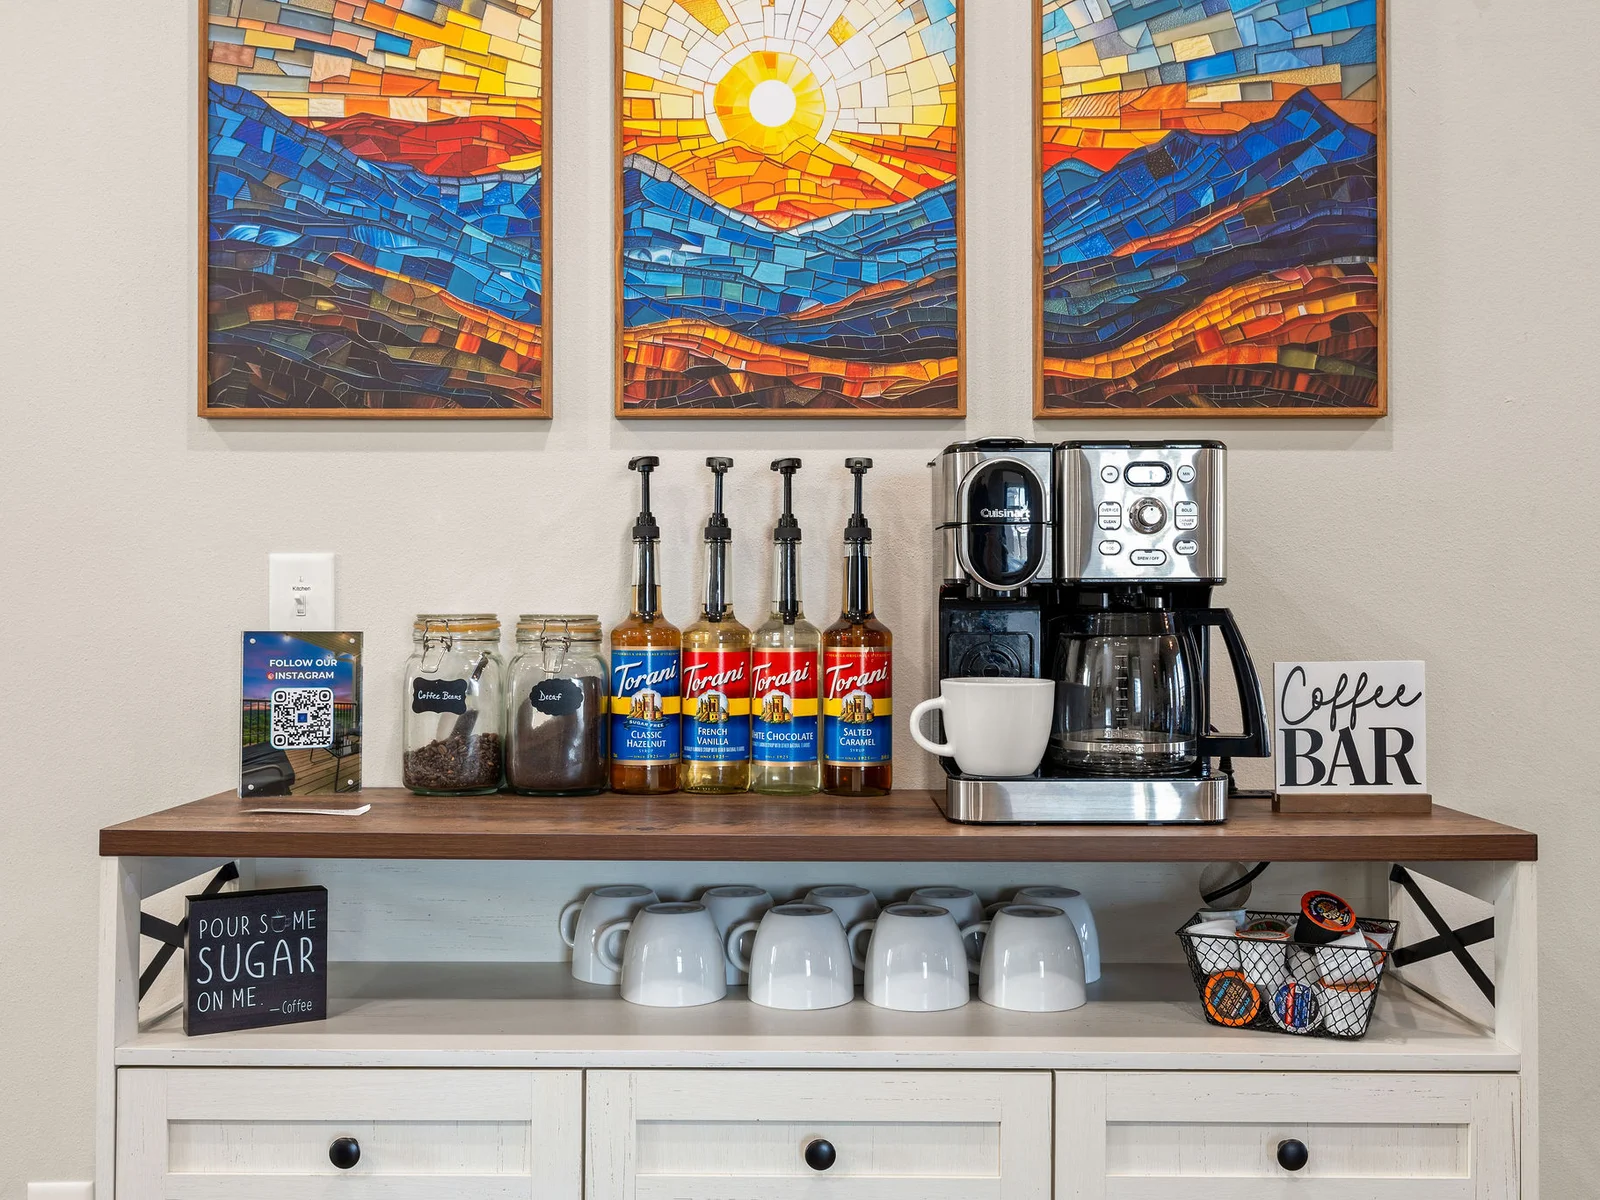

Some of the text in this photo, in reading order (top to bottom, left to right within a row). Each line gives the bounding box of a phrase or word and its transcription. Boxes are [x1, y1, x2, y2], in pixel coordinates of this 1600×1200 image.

[980, 508, 1030, 518] Cuisinart
[269, 659, 337, 667] FOLLOW OUR
[275, 672, 334, 680] INSTAGRAM
[614, 660, 677, 699] Torani
[683, 661, 744, 700] Torani
[752, 661, 810, 700] Torani
[826, 661, 888, 701] Torani
[418, 690, 461, 700] Coffee Beans
[538, 690, 562, 701] Decaf
[1281, 665, 1422, 732] Coffee
[631, 730, 662, 739] CLASSIC
[697, 727, 728, 736] FRENCH
[766, 731, 814, 741] CHOCOLATE
[843, 728, 872, 736] SALTED
[626, 739, 667, 748] HAZELNUT
[696, 737, 729, 745] VANILLA
[840, 737, 876, 746] CARAMEL
[1279, 726, 1422, 787] BAR
[200, 910, 316, 939] POUR SME
[197, 937, 315, 984] SUGAR
[197, 990, 223, 1012] ON
[232, 987, 264, 1008] ME.
